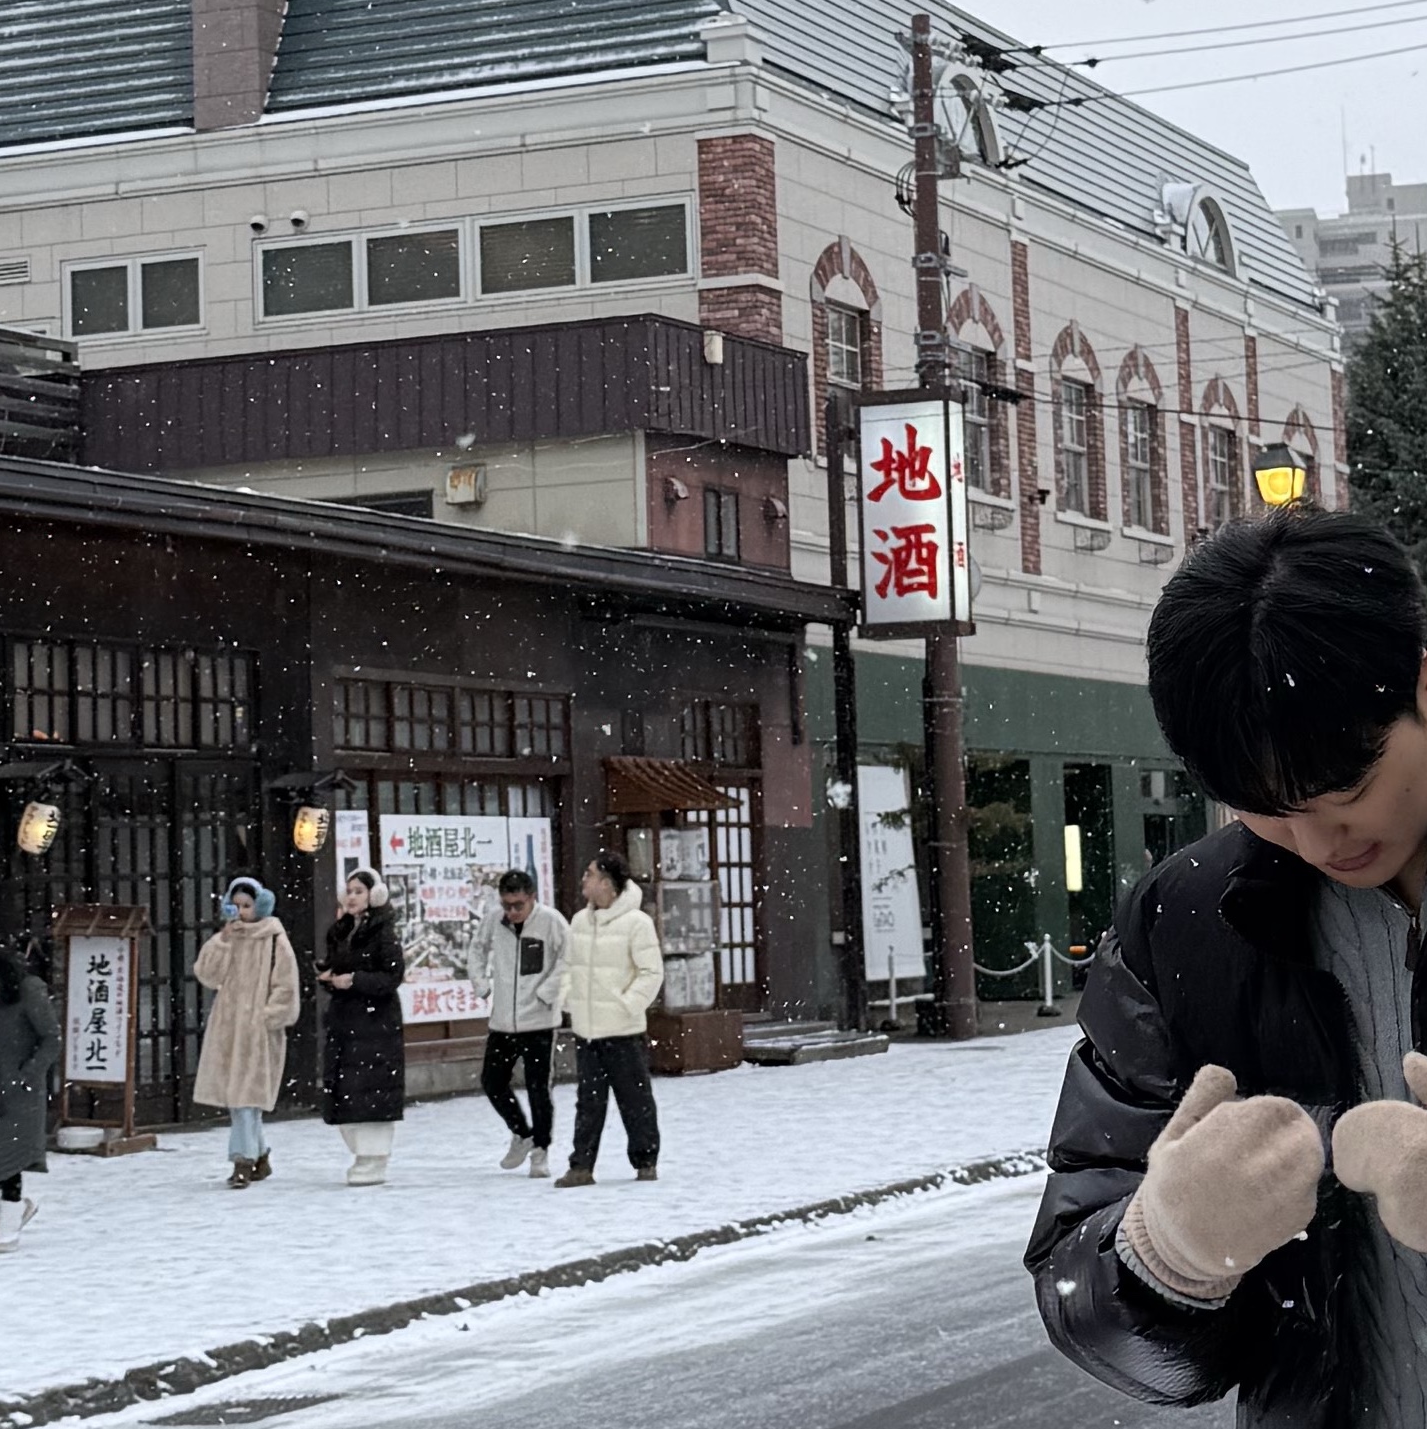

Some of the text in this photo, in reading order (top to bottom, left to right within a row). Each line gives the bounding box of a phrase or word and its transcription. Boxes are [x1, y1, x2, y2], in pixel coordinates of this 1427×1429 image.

[866, 423, 943, 600] 地酒
[408, 826, 492, 858] 地酒屋北一
[84, 953, 112, 1071] 地酒屋北一
